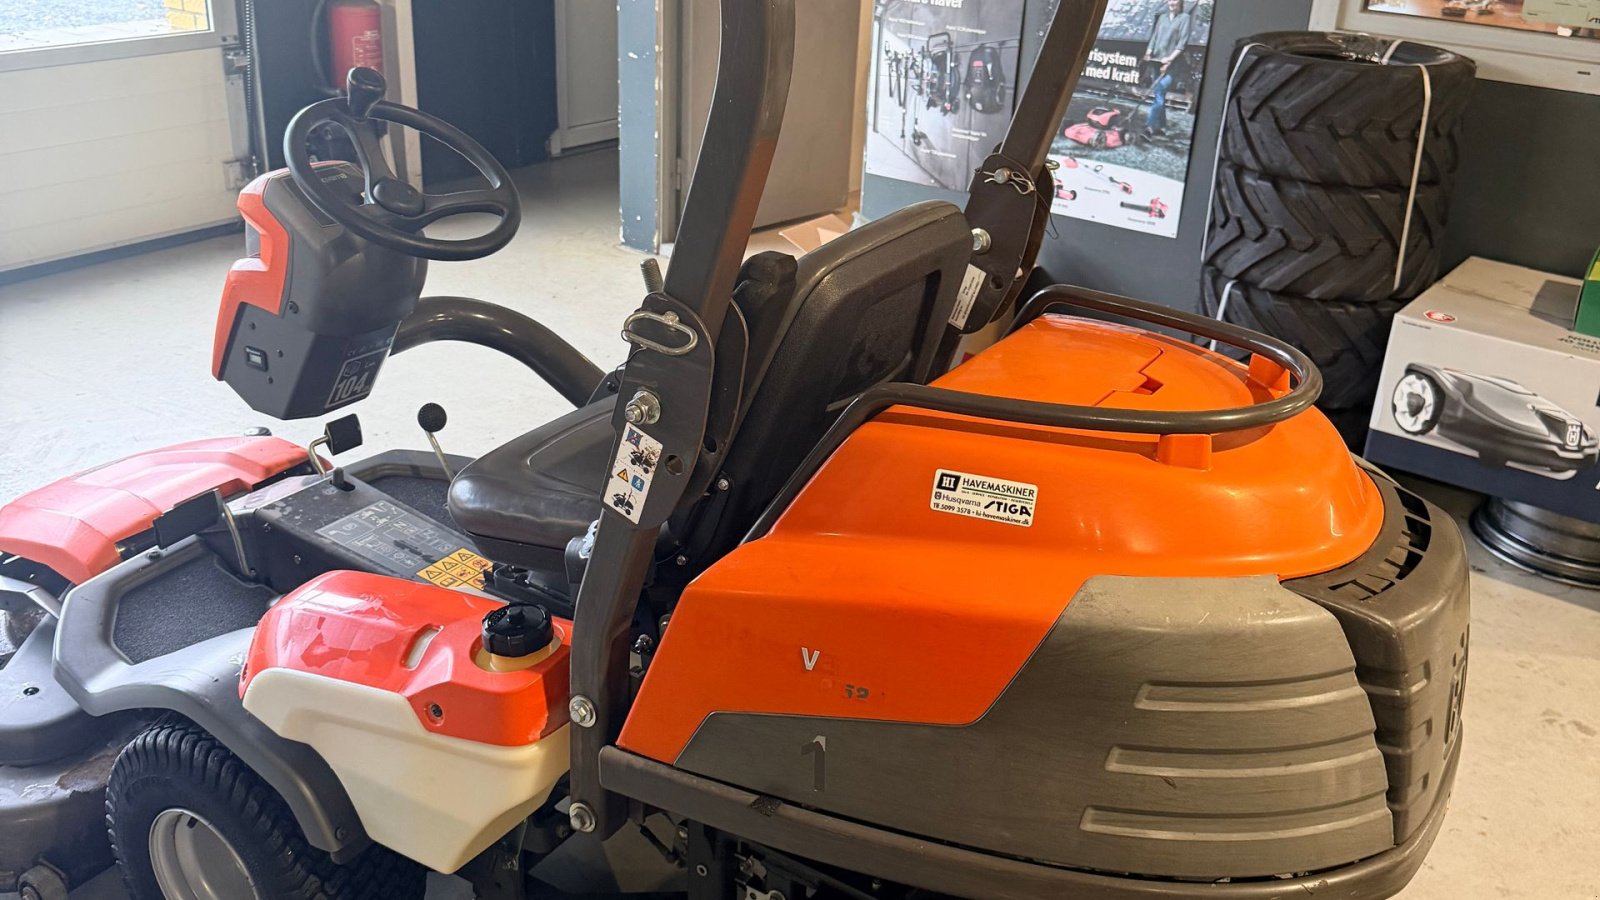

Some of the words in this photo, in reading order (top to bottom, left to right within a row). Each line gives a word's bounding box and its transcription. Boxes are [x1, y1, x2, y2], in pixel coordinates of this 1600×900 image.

[1085, 66, 1111, 80] med
[1111, 67, 1139, 84] kraft
[335, 371, 369, 401] 104
[962, 478, 1035, 498] HAVEMASKINER
[942, 494, 981, 507] Husqvarna
[984, 501, 1031, 517] STIGA
